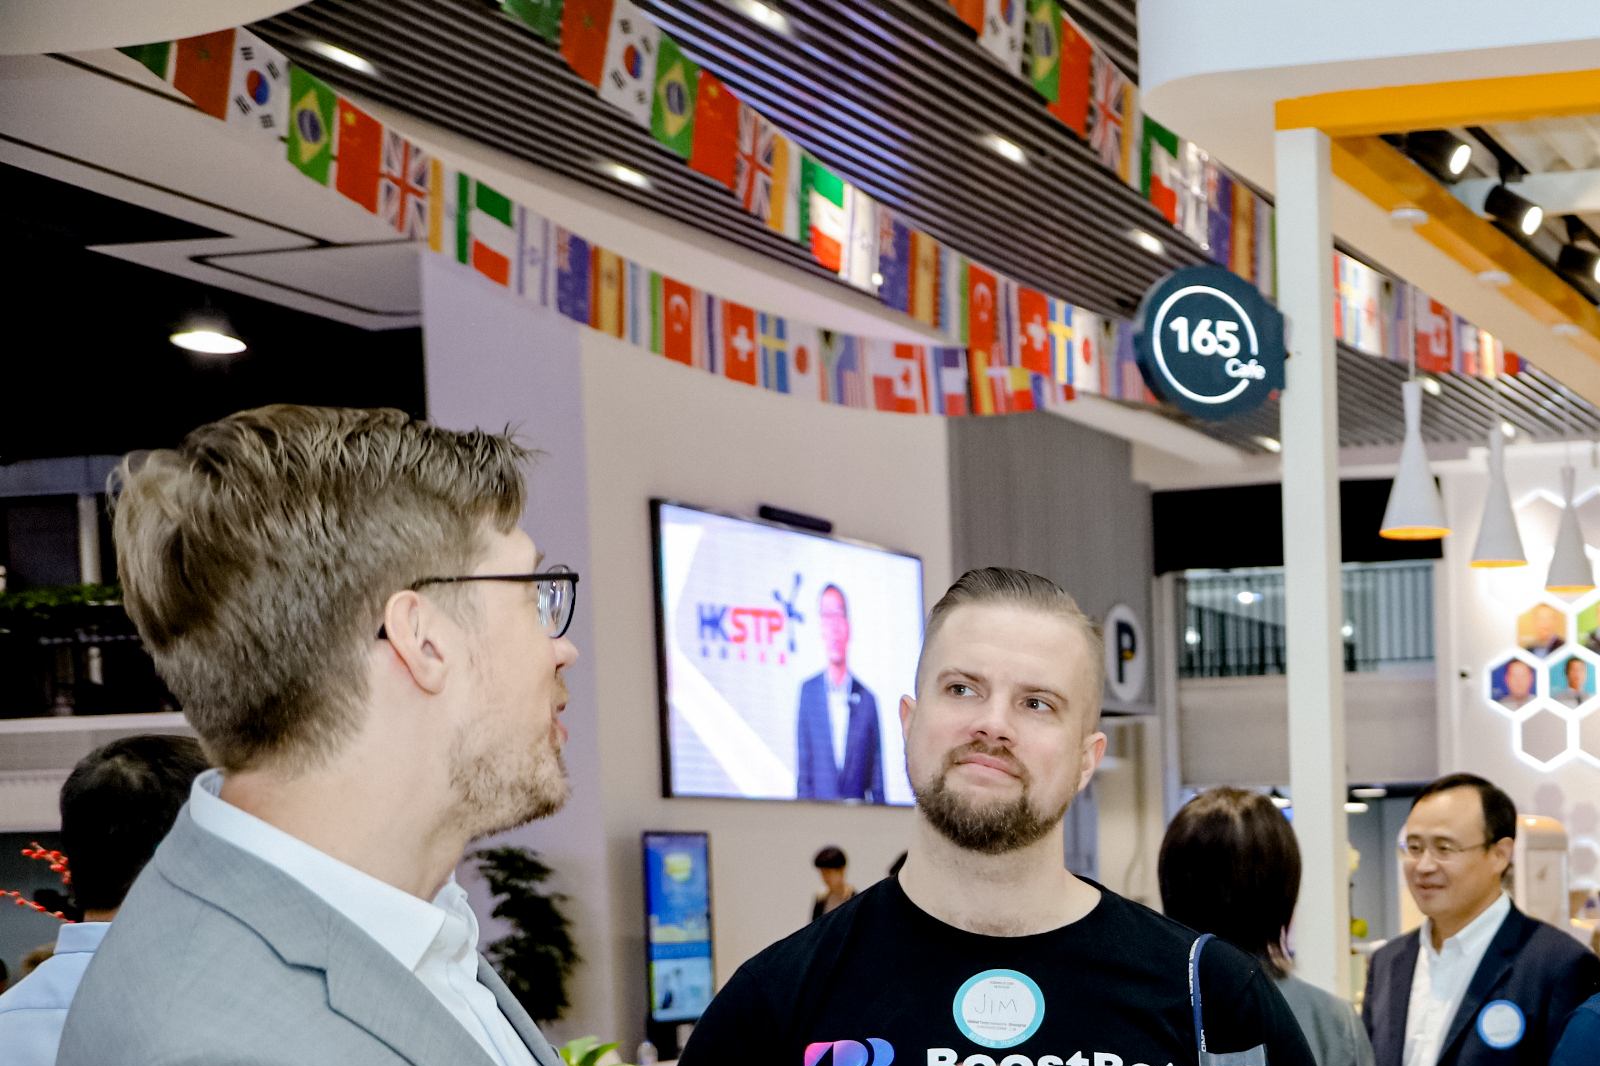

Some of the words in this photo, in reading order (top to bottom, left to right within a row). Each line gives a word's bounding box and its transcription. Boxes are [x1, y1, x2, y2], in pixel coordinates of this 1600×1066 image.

[1169, 316, 1240, 358] 165
[1115, 618, 1137, 684] P
[974, 993, 1018, 1015] JIM
